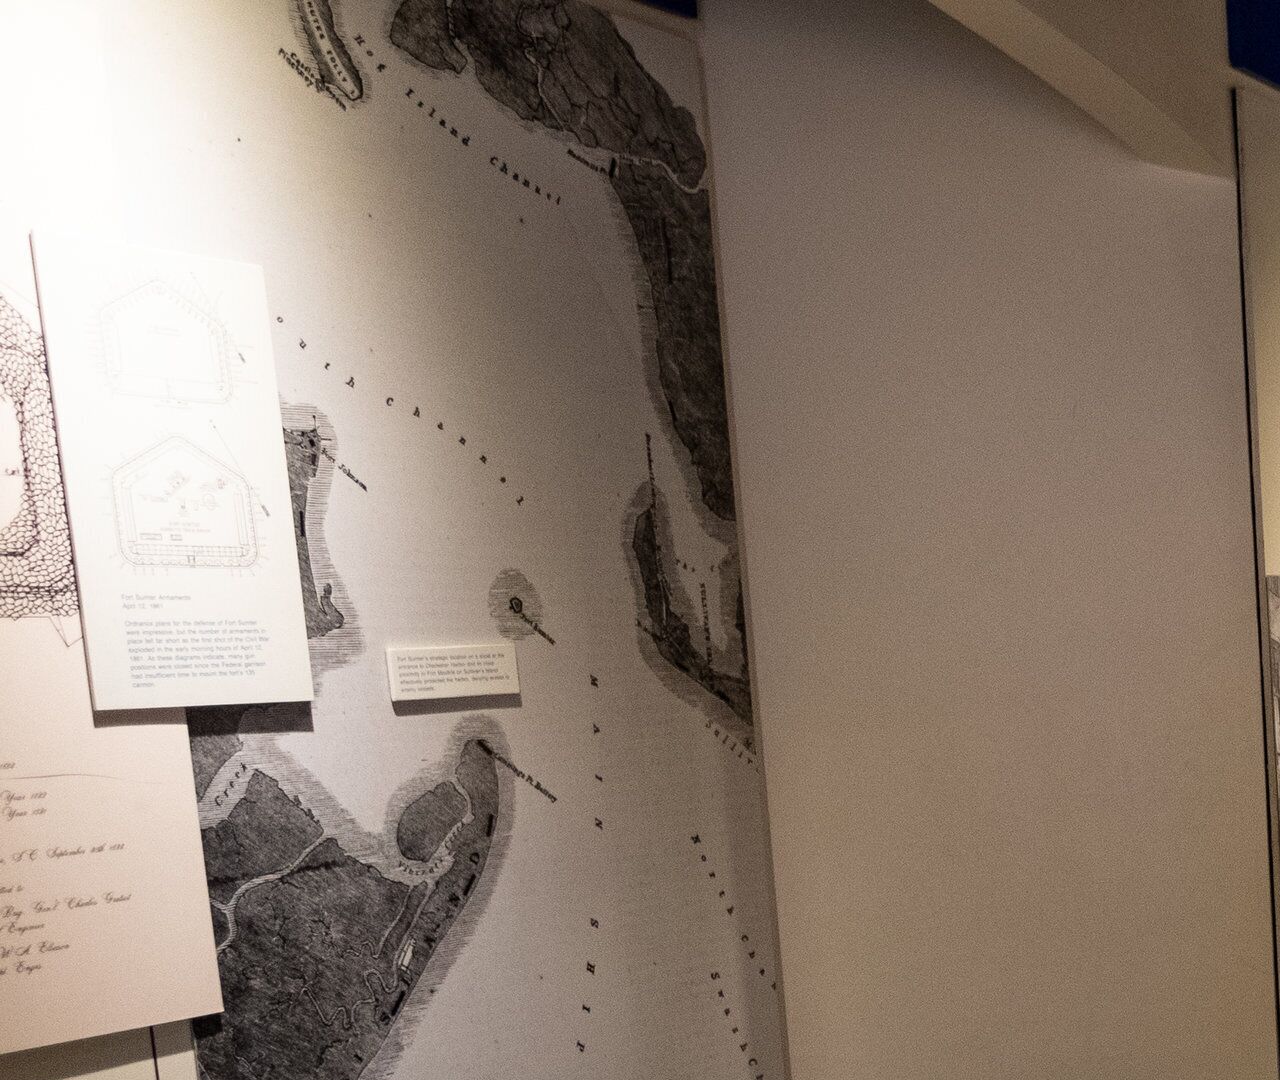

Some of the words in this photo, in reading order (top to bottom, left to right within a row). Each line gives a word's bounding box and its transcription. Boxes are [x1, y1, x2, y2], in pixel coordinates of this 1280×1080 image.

[405, 88, 471, 147] Island
[489, 155, 562, 206] Channel
[338, 464, 368, 493] Johnson
[386, 396, 526, 507] Channel
[122, 602, 136, 610] April
[214, 762, 247, 807] Creek
[589, 674, 605, 831] MAIN
[576, 917, 600, 1055] SHIP
